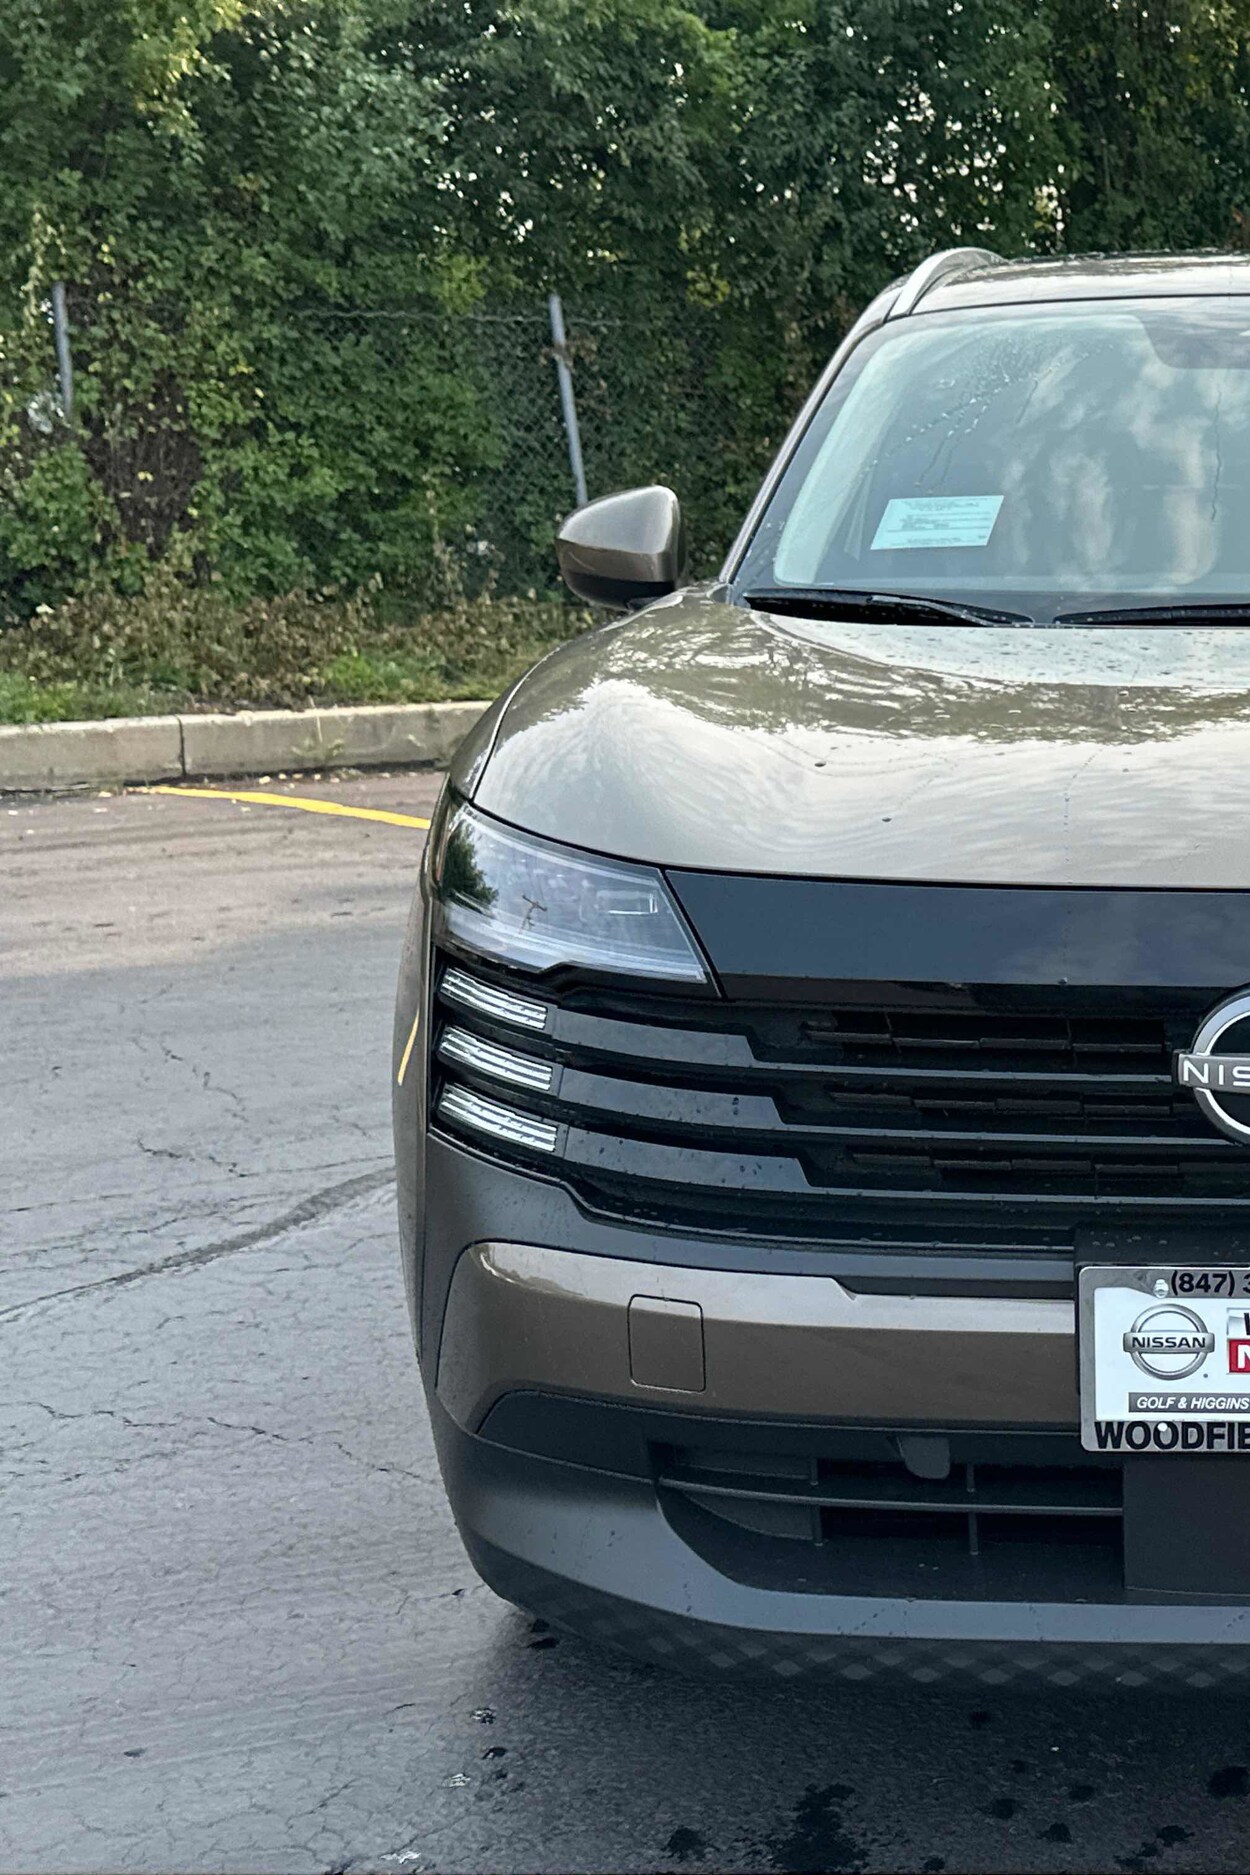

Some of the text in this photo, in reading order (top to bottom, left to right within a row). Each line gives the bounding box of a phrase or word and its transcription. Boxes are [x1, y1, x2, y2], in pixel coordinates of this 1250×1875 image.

[1171, 1270, 1235, 1297] (847)
[1131, 1336, 1206, 1349] NISSAN
[1136, 1396, 1177, 1411] GOLF
[1178, 1397, 1188, 1411] &
[1190, 1397, 1250, 1411] HIGGINS
